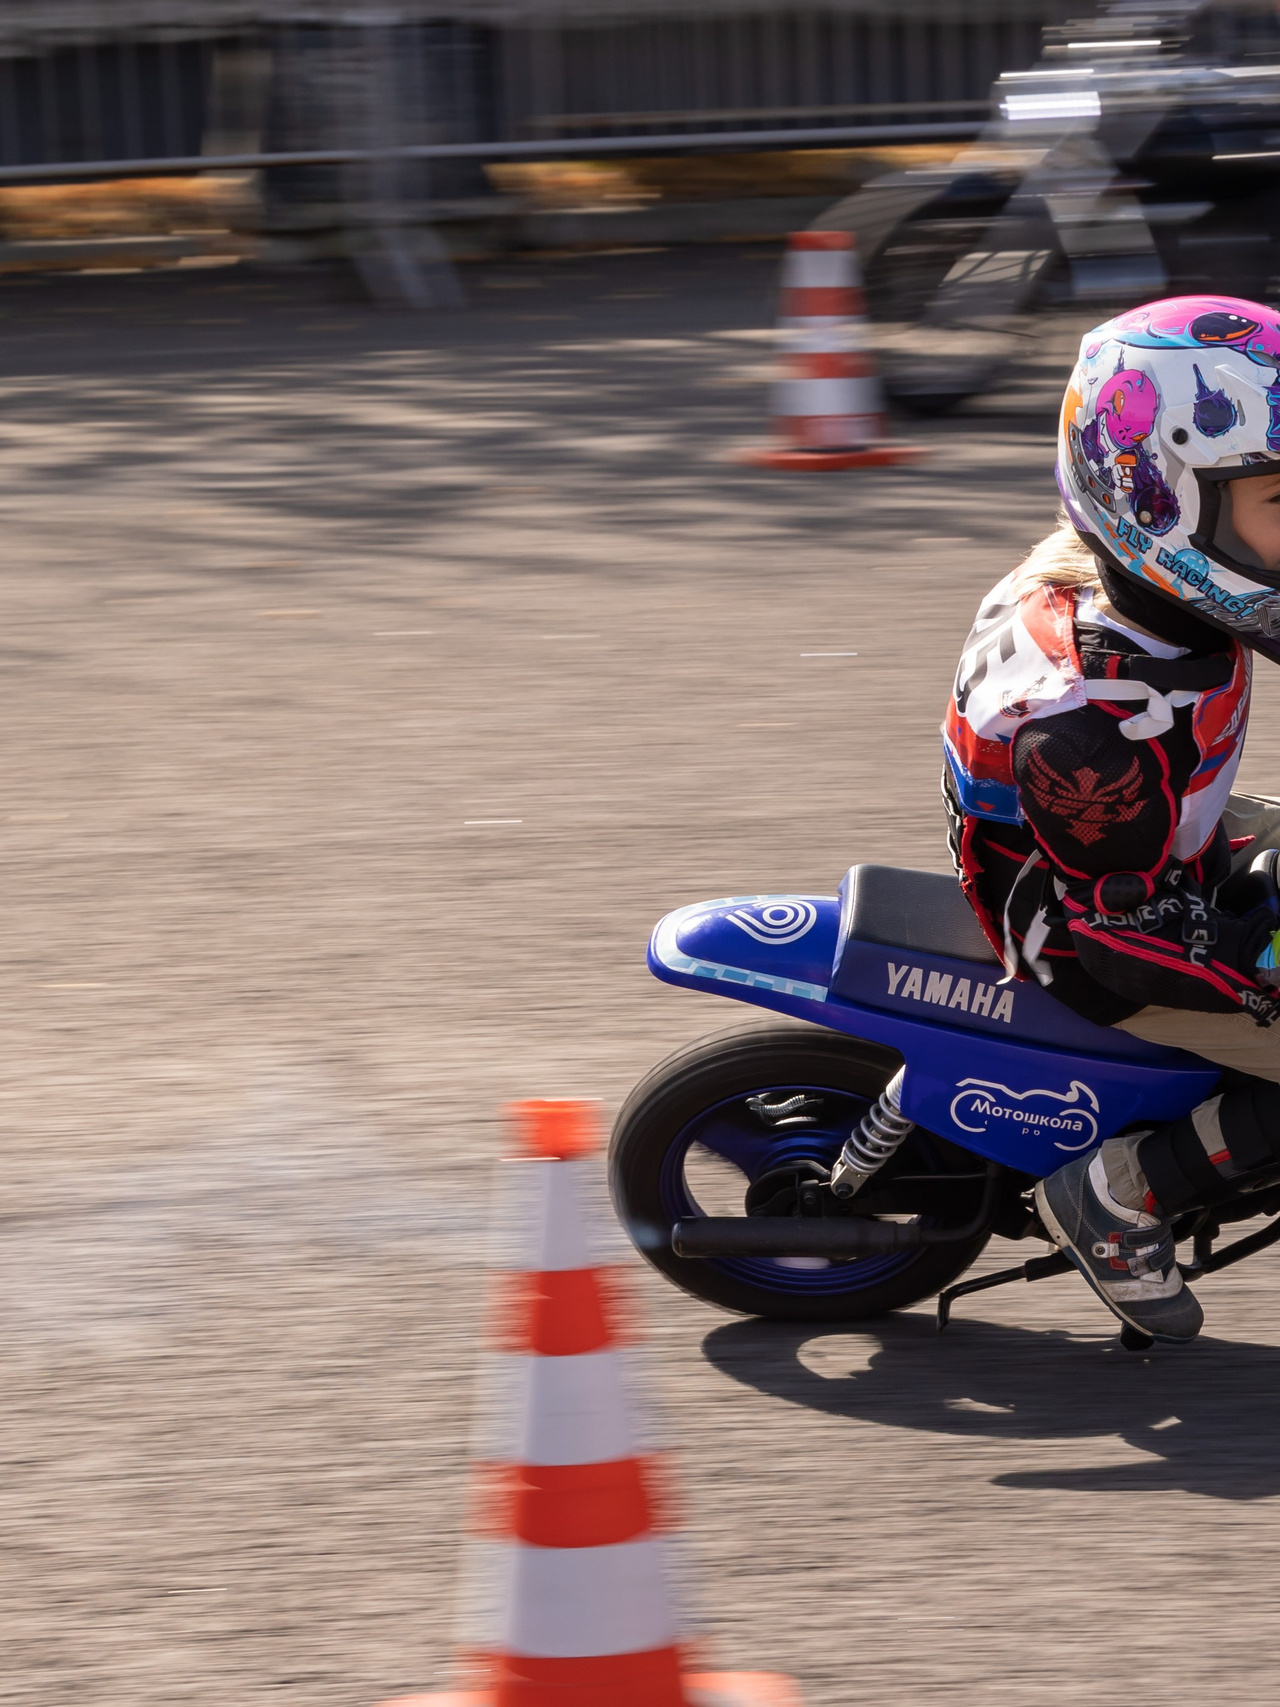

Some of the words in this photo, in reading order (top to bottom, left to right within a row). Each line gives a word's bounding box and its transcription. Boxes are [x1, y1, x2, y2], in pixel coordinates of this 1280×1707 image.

[1116, 516, 1153, 554] FLY
[1155, 547, 1257, 620] RACING!
[887, 962, 1014, 1023] YAMAHA
[970, 1098, 1083, 1132] Мотошкола
